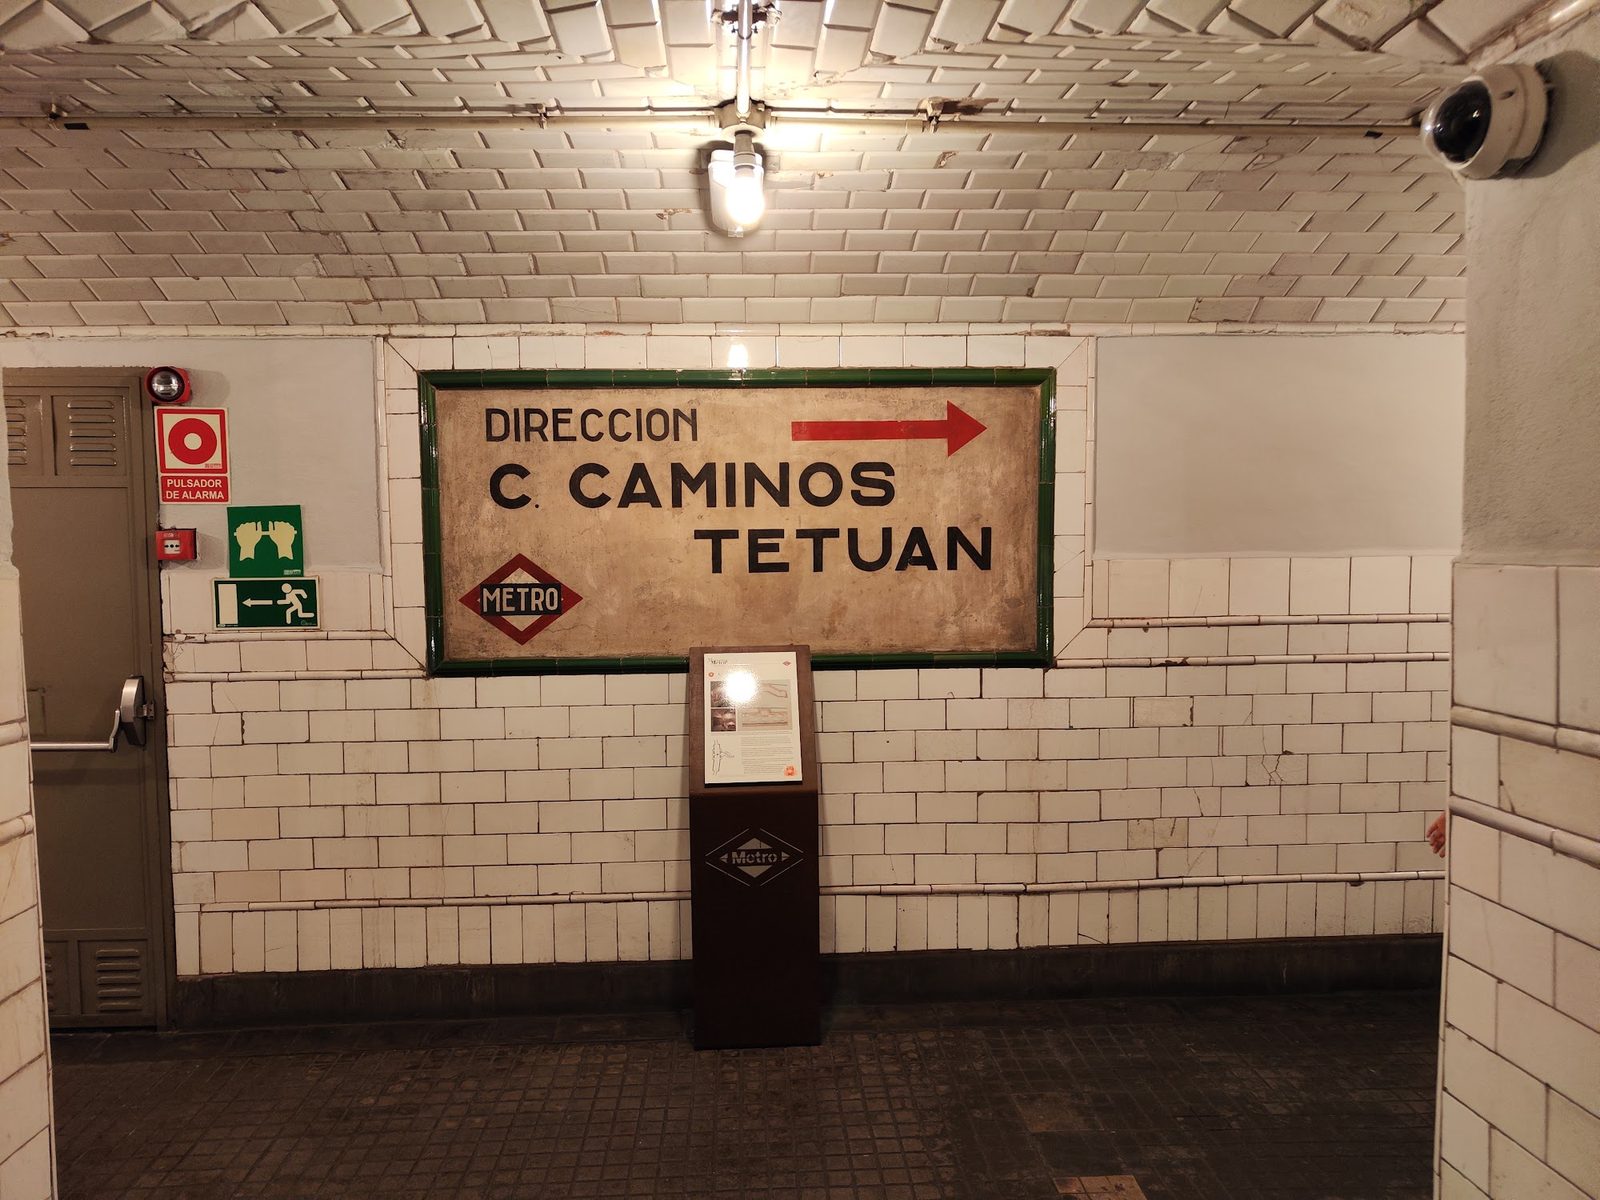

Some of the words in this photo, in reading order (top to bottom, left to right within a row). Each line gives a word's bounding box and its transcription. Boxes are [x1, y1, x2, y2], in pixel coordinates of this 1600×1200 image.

[485, 407, 698, 443] DIRECCION
[166, 490, 180, 499] DE
[182, 490, 225, 500] ALARMA
[167, 478, 222, 488] PULSADOR
[489, 463, 540, 510] C.
[568, 461, 896, 509] CAMINOS
[693, 526, 993, 574] TETUAN
[482, 587, 559, 613] METRO
[731, 850, 778, 865] Metro
